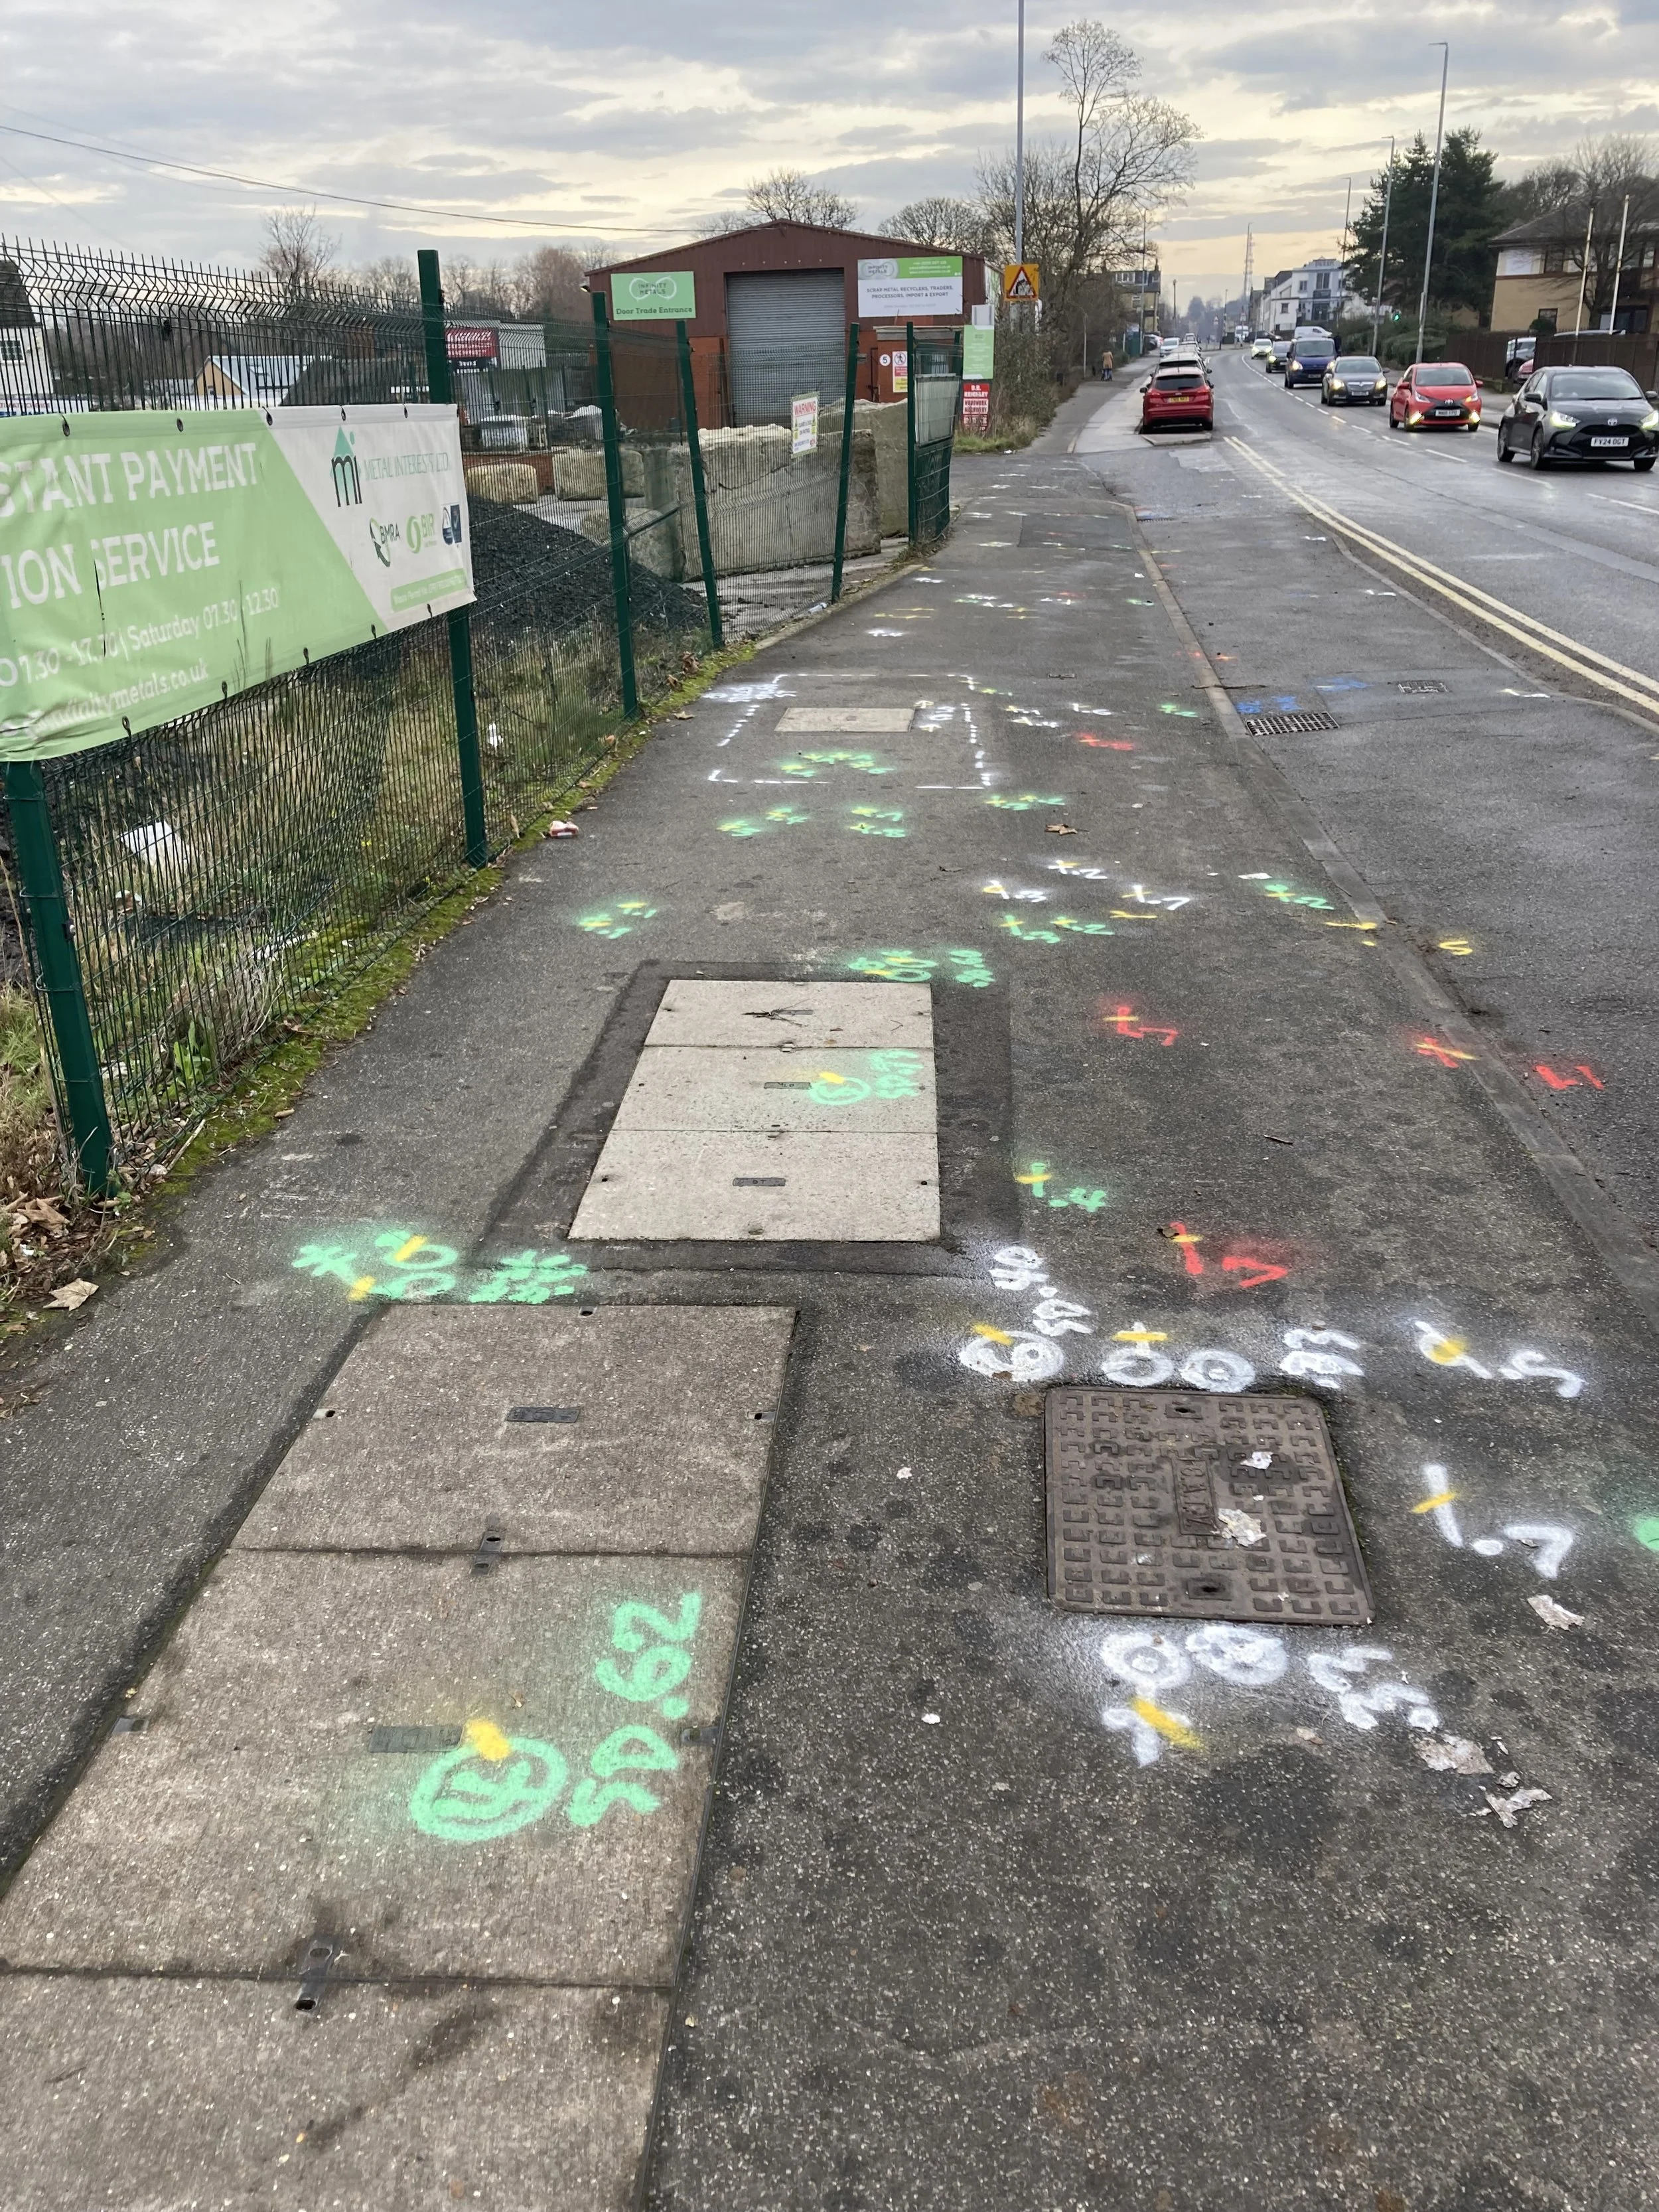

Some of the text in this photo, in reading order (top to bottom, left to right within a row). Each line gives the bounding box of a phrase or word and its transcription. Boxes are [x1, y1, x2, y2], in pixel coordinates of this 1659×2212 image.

[794, 400, 816, 416] WARNING
[120, 442, 258, 501] PAYMENT
[380, 522, 401, 544] BMRA
[421, 512, 435, 538] BIR
[90, 521, 220, 593] SERVICE
[126, 613, 202, 652] Saturday
[202, 598, 239, 630] 07.30
[246, 587, 280, 617] 12.30
